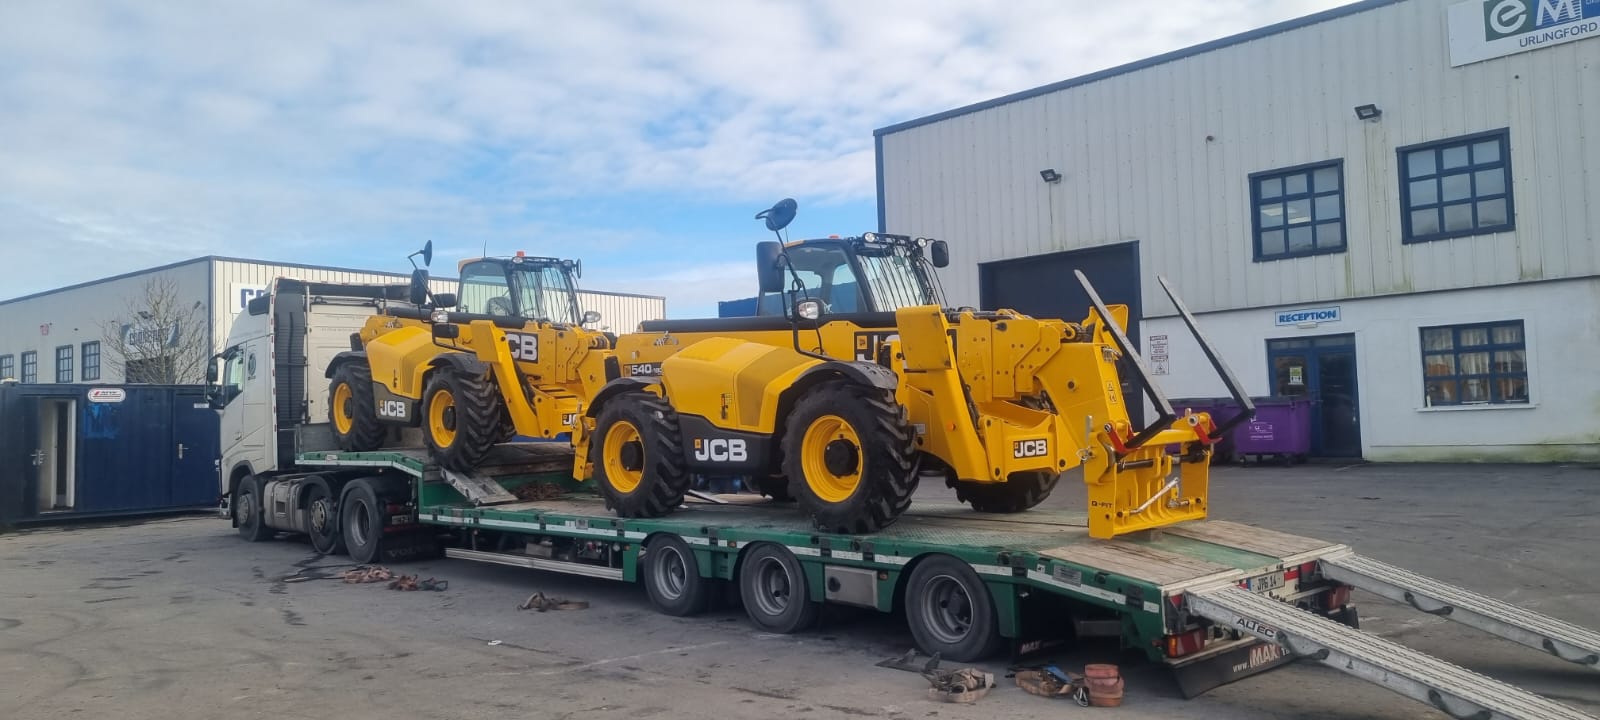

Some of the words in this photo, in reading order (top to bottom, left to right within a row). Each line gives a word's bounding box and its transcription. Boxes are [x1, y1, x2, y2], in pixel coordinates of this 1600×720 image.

[1519, 22, 1597, 48] URLINGFORD
[1279, 310, 1337, 323] RECEPTION
[506, 333, 537, 361] CB
[379, 400, 406, 417] JCB
[694, 438, 748, 462] JCB
[1014, 439, 1047, 458] JCB
[1236, 617, 1274, 638] ALTEC
